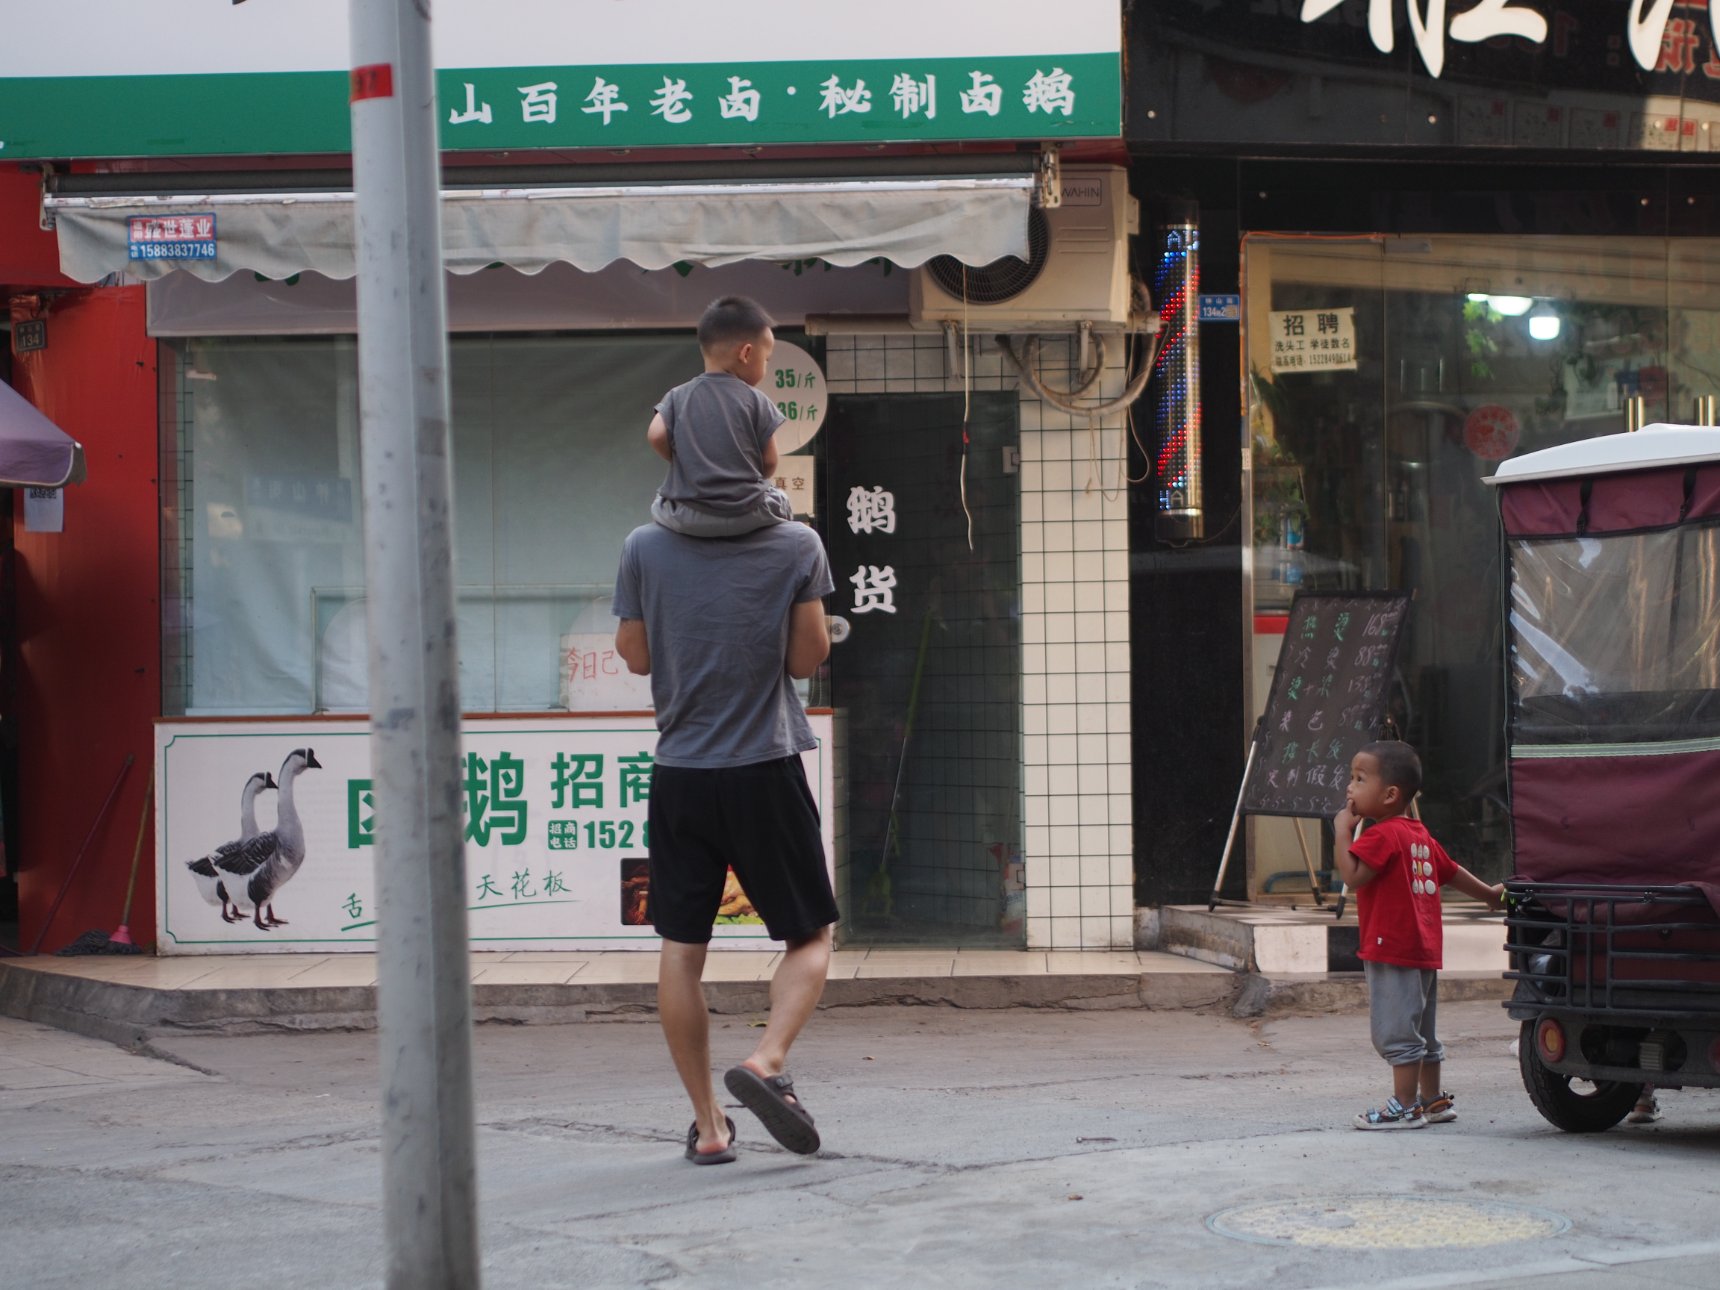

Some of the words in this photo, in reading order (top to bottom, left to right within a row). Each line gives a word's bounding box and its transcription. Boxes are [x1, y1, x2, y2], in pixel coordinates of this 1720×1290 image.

[140, 243, 215, 257] 15883837746
[1283, 312, 1339, 337] 招聘
[775, 369, 816, 389] 35/斤
[774, 477, 805, 491] 真空
[846, 485, 897, 614] 鹅货
[476, 868, 573, 901] 天花板
